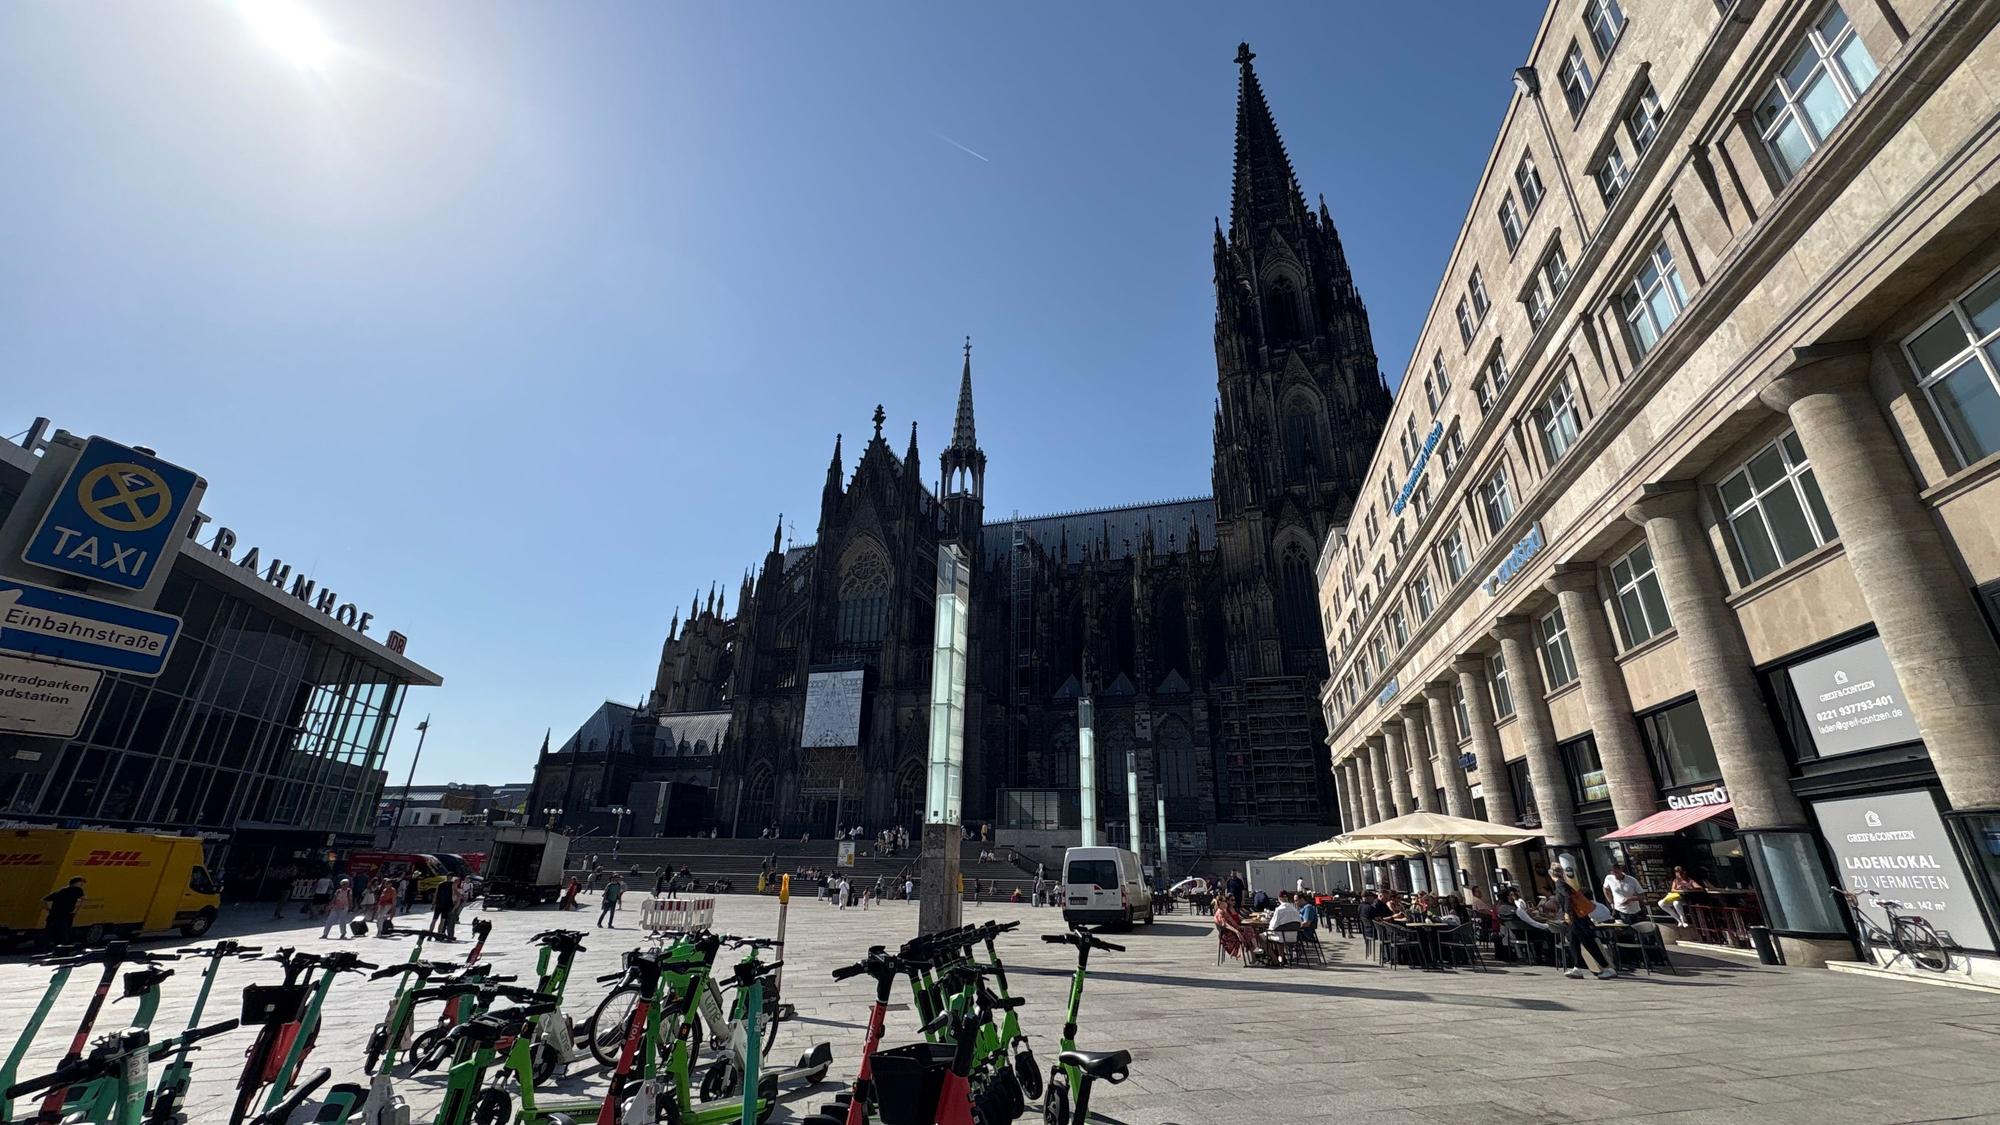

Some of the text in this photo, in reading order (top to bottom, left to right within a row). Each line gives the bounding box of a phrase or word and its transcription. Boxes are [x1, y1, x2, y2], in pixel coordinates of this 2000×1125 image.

[53, 525, 148, 577] TAXI
[4, 608, 159, 651] Einbahnstraße
[390, 634, 404, 654] DB
[1817, 694, 1894, 722] 0221 937793-401
[1667, 787, 1728, 810] GALESTRO
[86, 850, 142, 867] DHL
[1845, 855, 1941, 869] LADENLOKAL
[1851, 875, 1950, 890] ZU VERMIETEN
